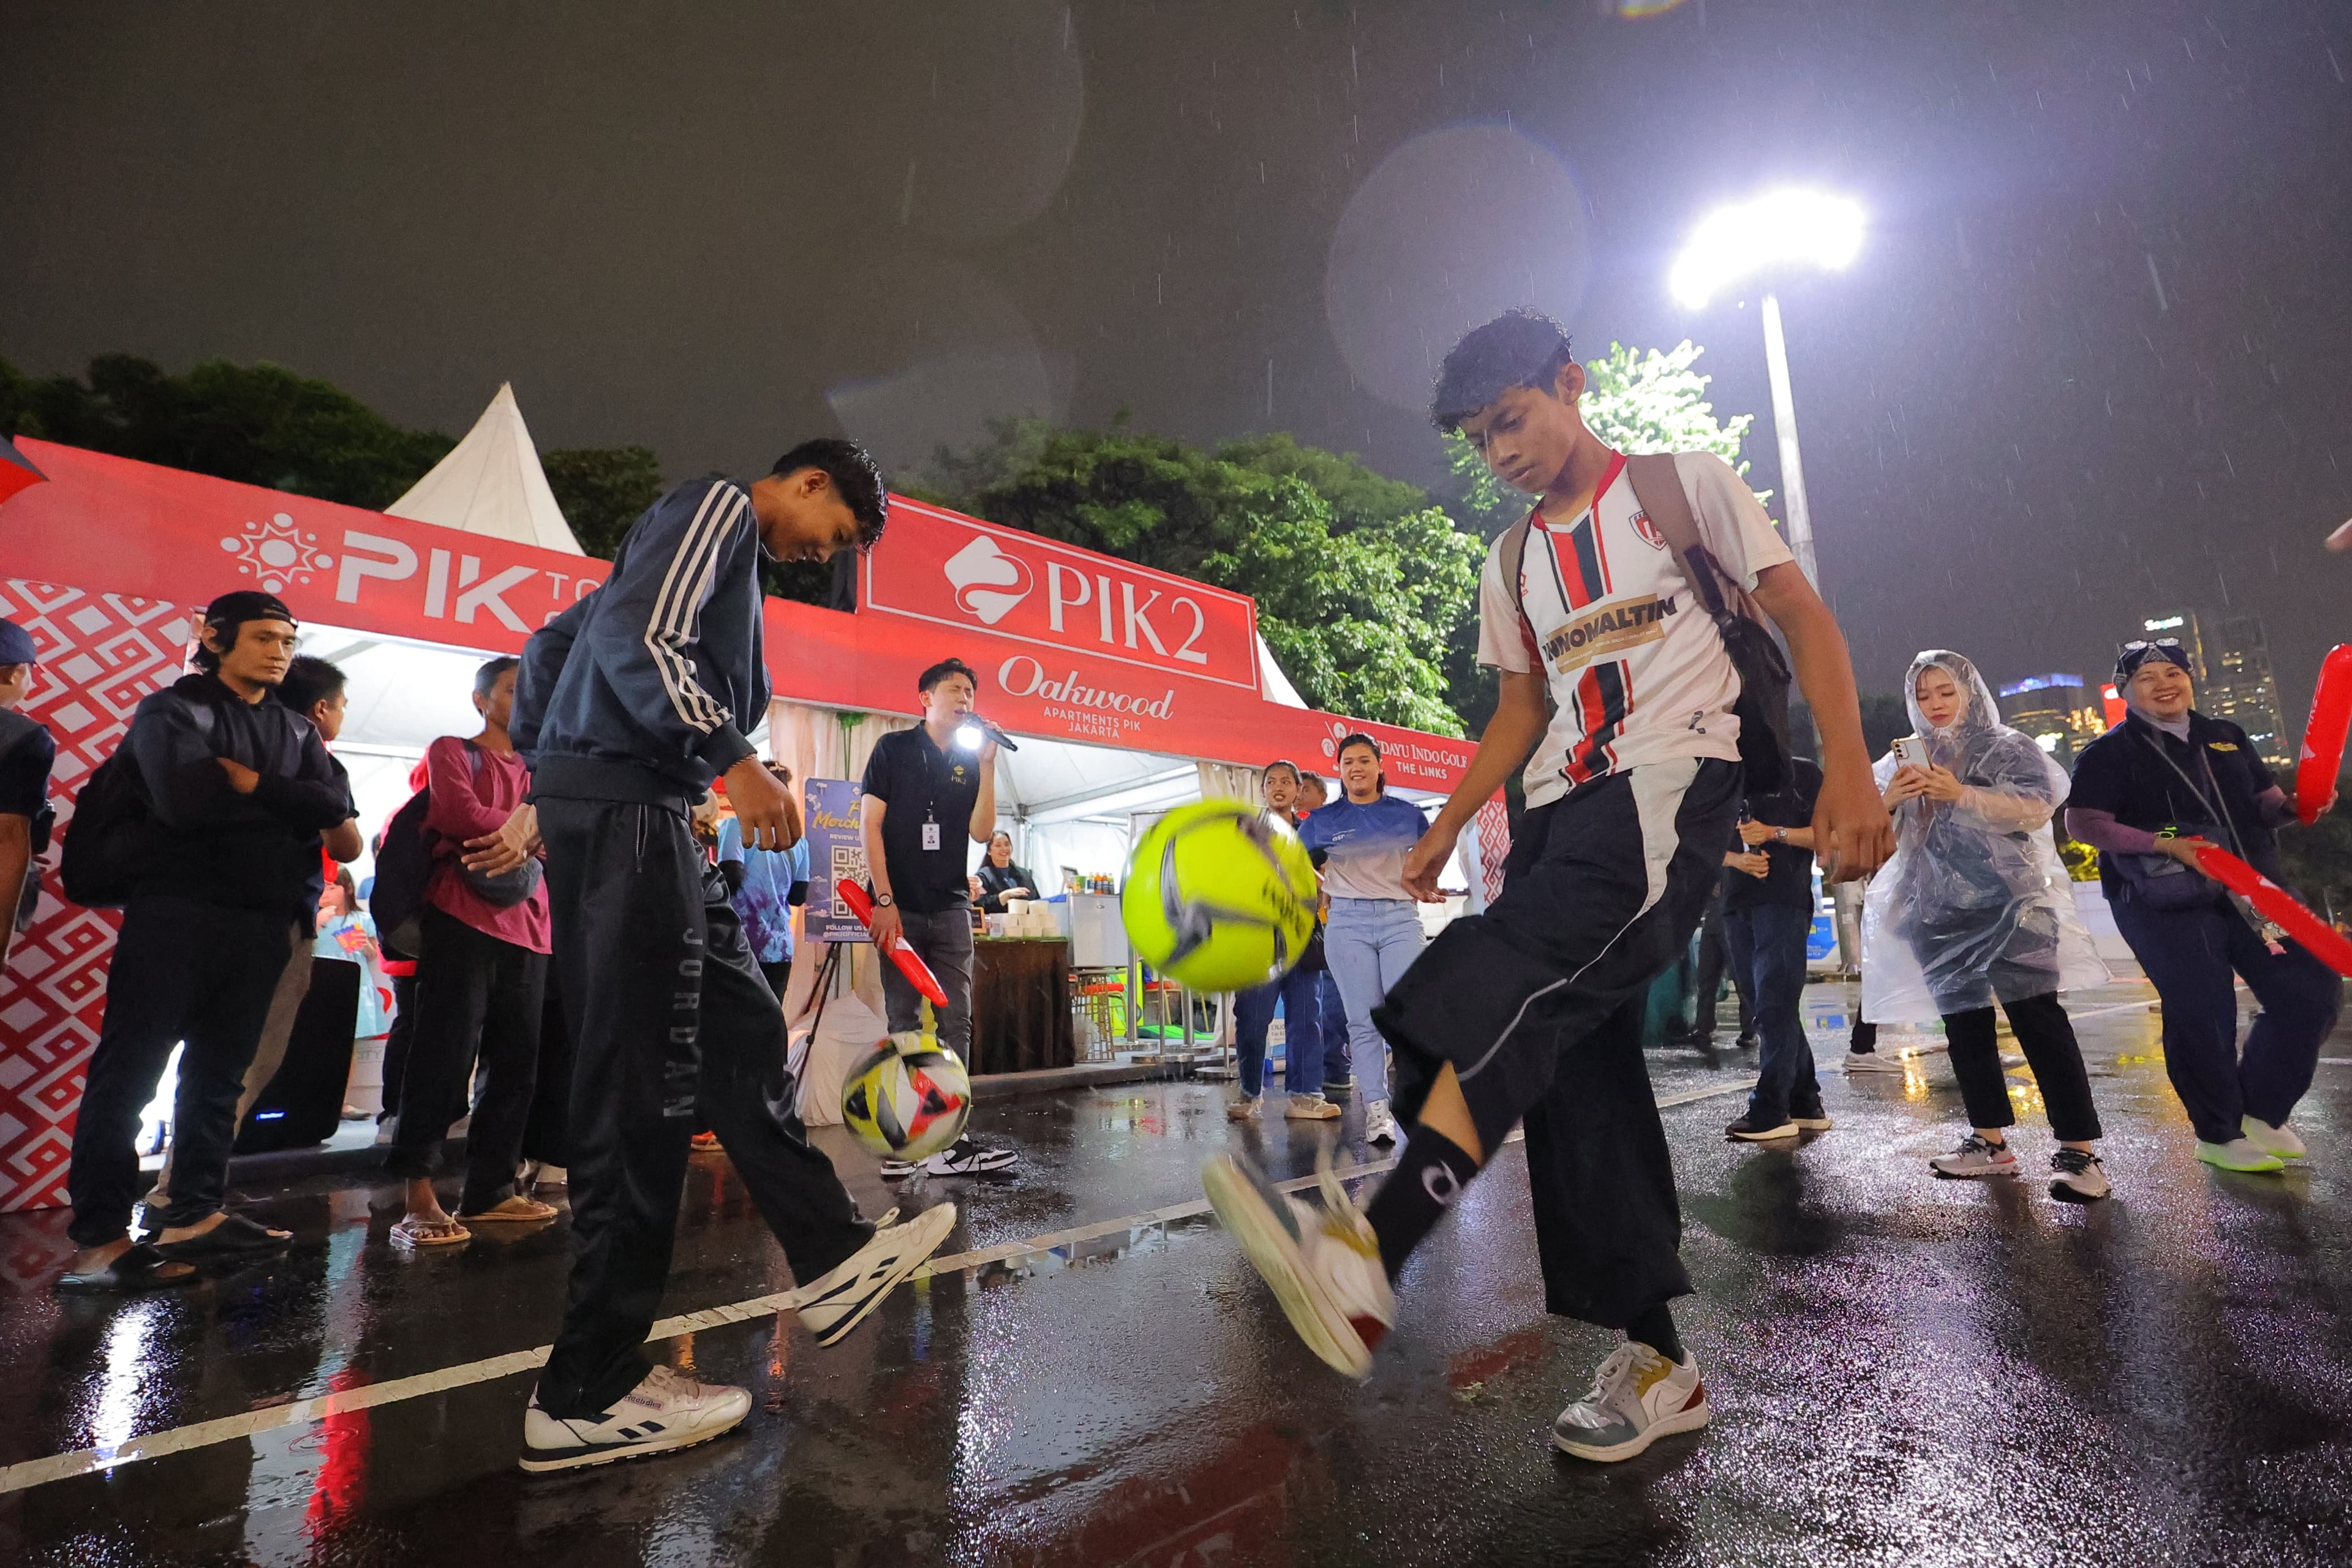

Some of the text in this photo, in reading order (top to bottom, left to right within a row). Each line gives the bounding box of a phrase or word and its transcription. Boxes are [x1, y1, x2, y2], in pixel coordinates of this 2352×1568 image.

[335, 530, 538, 634] PIK
[1046, 560, 1207, 665] PIK2
[998, 655, 1174, 720] Oakwood
[1043, 706, 1140, 731] APARTMENTS PIK
[1068, 721, 1120, 738] JAKARTA
[1411, 744, 1439, 764] INDO
[1441, 750, 1468, 768] GOLF
[1396, 761, 1447, 780] THE LINKS
